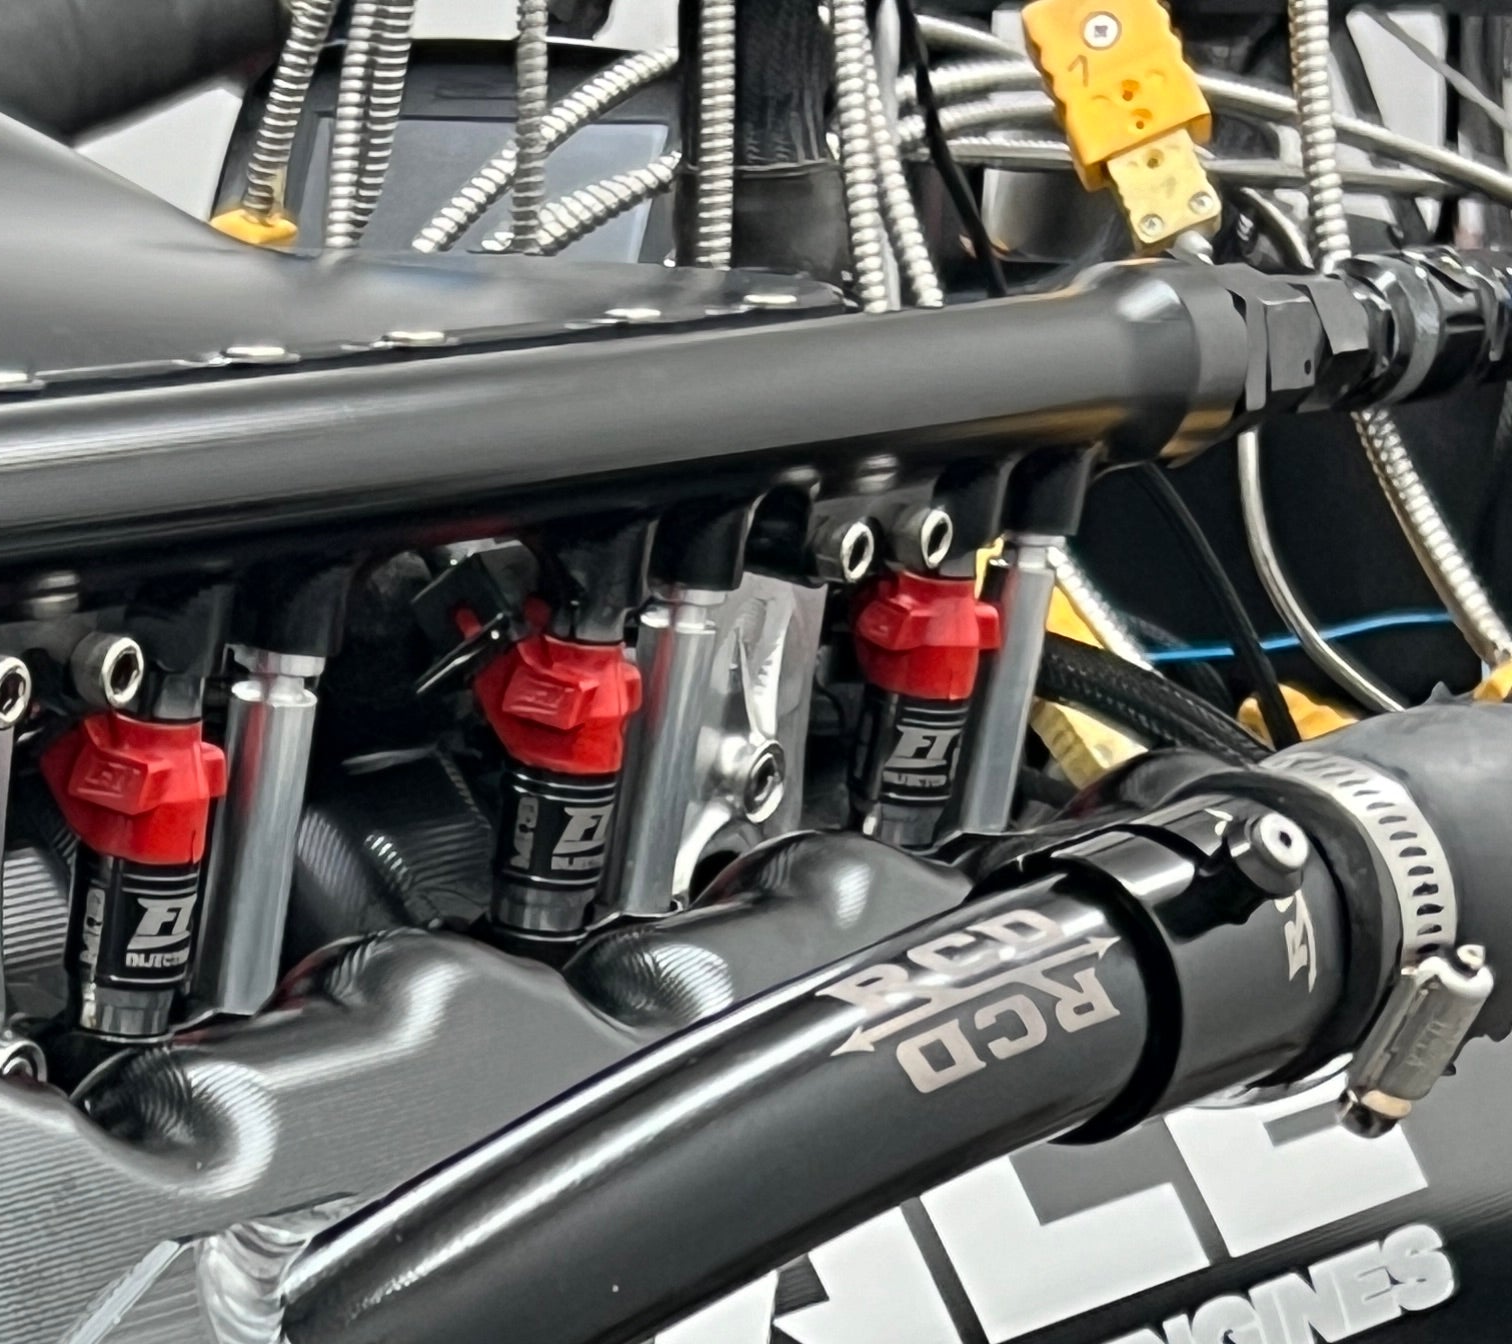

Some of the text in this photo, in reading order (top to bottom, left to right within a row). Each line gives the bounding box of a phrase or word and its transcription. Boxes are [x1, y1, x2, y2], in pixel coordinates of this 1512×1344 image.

[896, 725, 963, 760] FT
[563, 803, 614, 842] FT
[137, 892, 197, 936] FT
[815, 909, 1066, 1020] RCD
[895, 967, 1121, 1095] RCD
